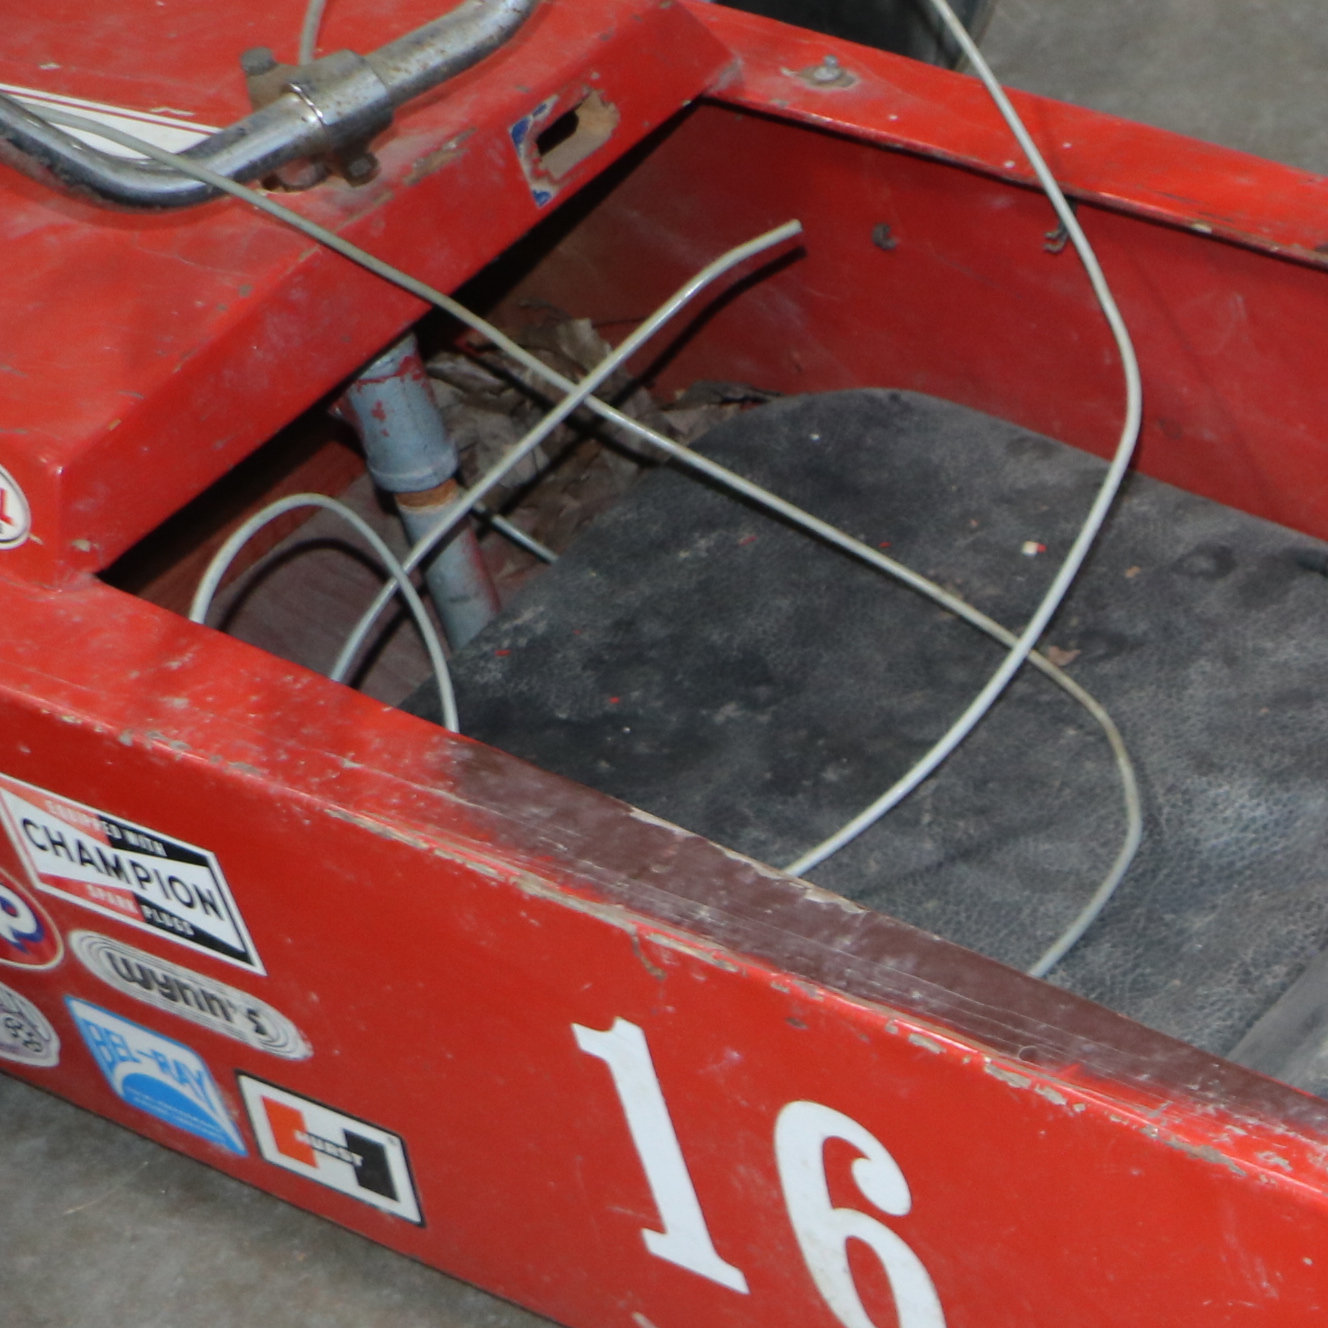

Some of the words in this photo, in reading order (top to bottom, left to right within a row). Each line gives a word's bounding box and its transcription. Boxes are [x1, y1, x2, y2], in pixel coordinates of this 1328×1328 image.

[124, 828, 167, 857] WITH
[22, 818, 225, 921] CHAMPION
[142, 904, 194, 937] PLUGS
